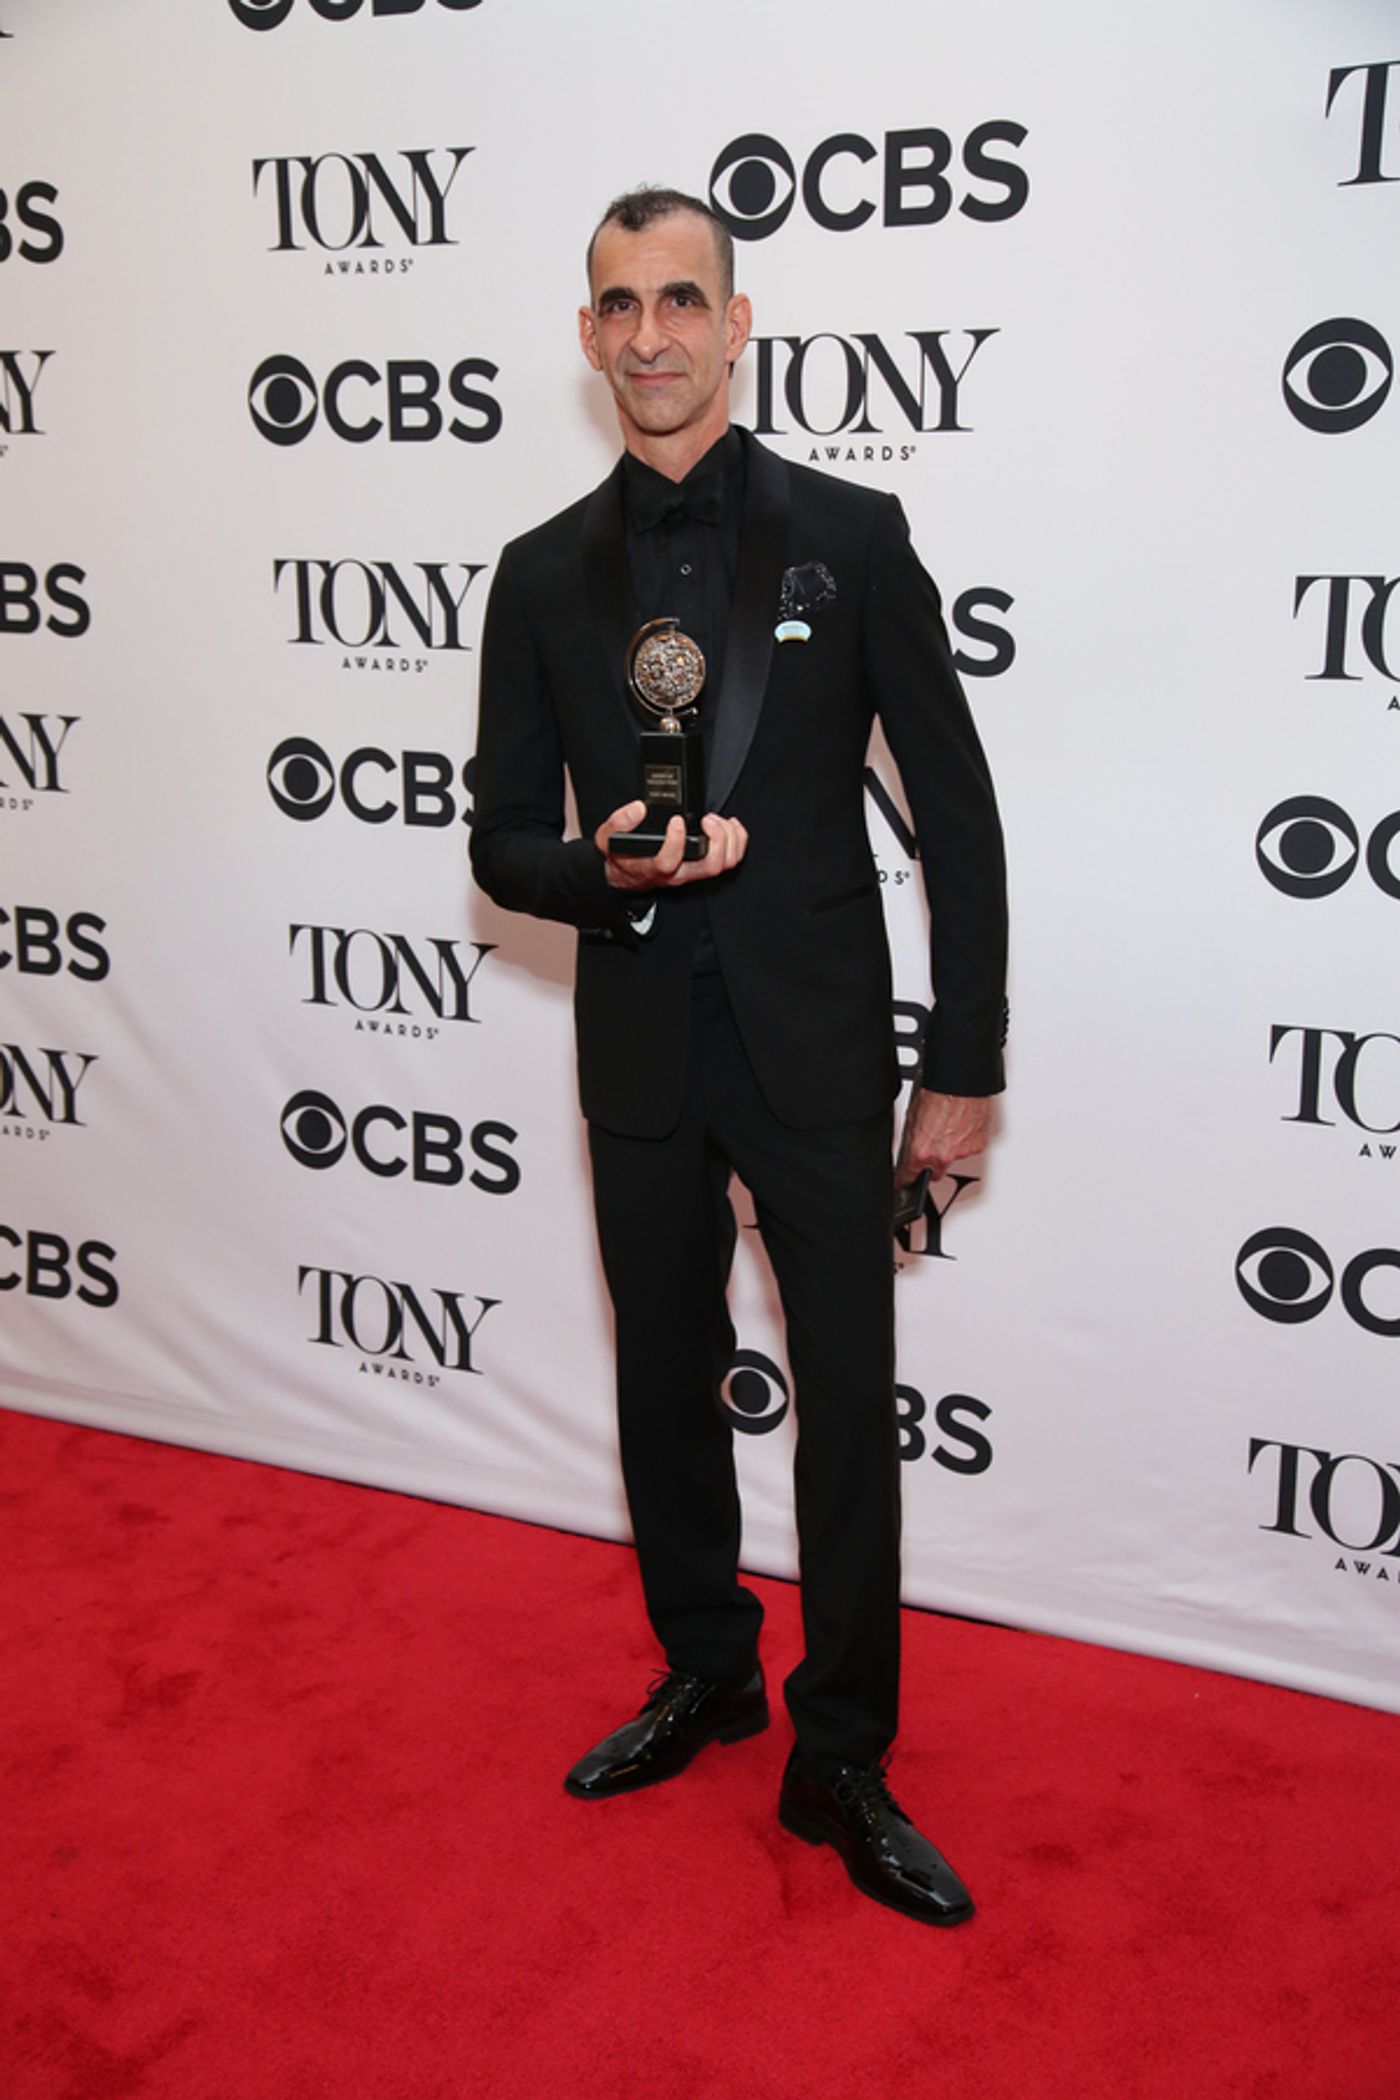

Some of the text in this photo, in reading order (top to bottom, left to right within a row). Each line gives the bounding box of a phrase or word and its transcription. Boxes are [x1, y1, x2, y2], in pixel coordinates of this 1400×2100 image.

[252, 146, 476, 251] TONY
[802, 119, 1030, 232] CBS
[323, 358, 503, 444] CBS
[748, 328, 1000, 436] TONY
[273, 558, 488, 651] TONY
[0, 906, 111, 983] BS
[289, 923, 498, 1023] TONY
[0, 1043, 99, 1127] NY
[351, 1104, 521, 1196] CBS
[298, 1265, 502, 1375] TONY
[1247, 1437, 1400, 1559] TO
[1334, 1557, 1400, 1584] AWA
